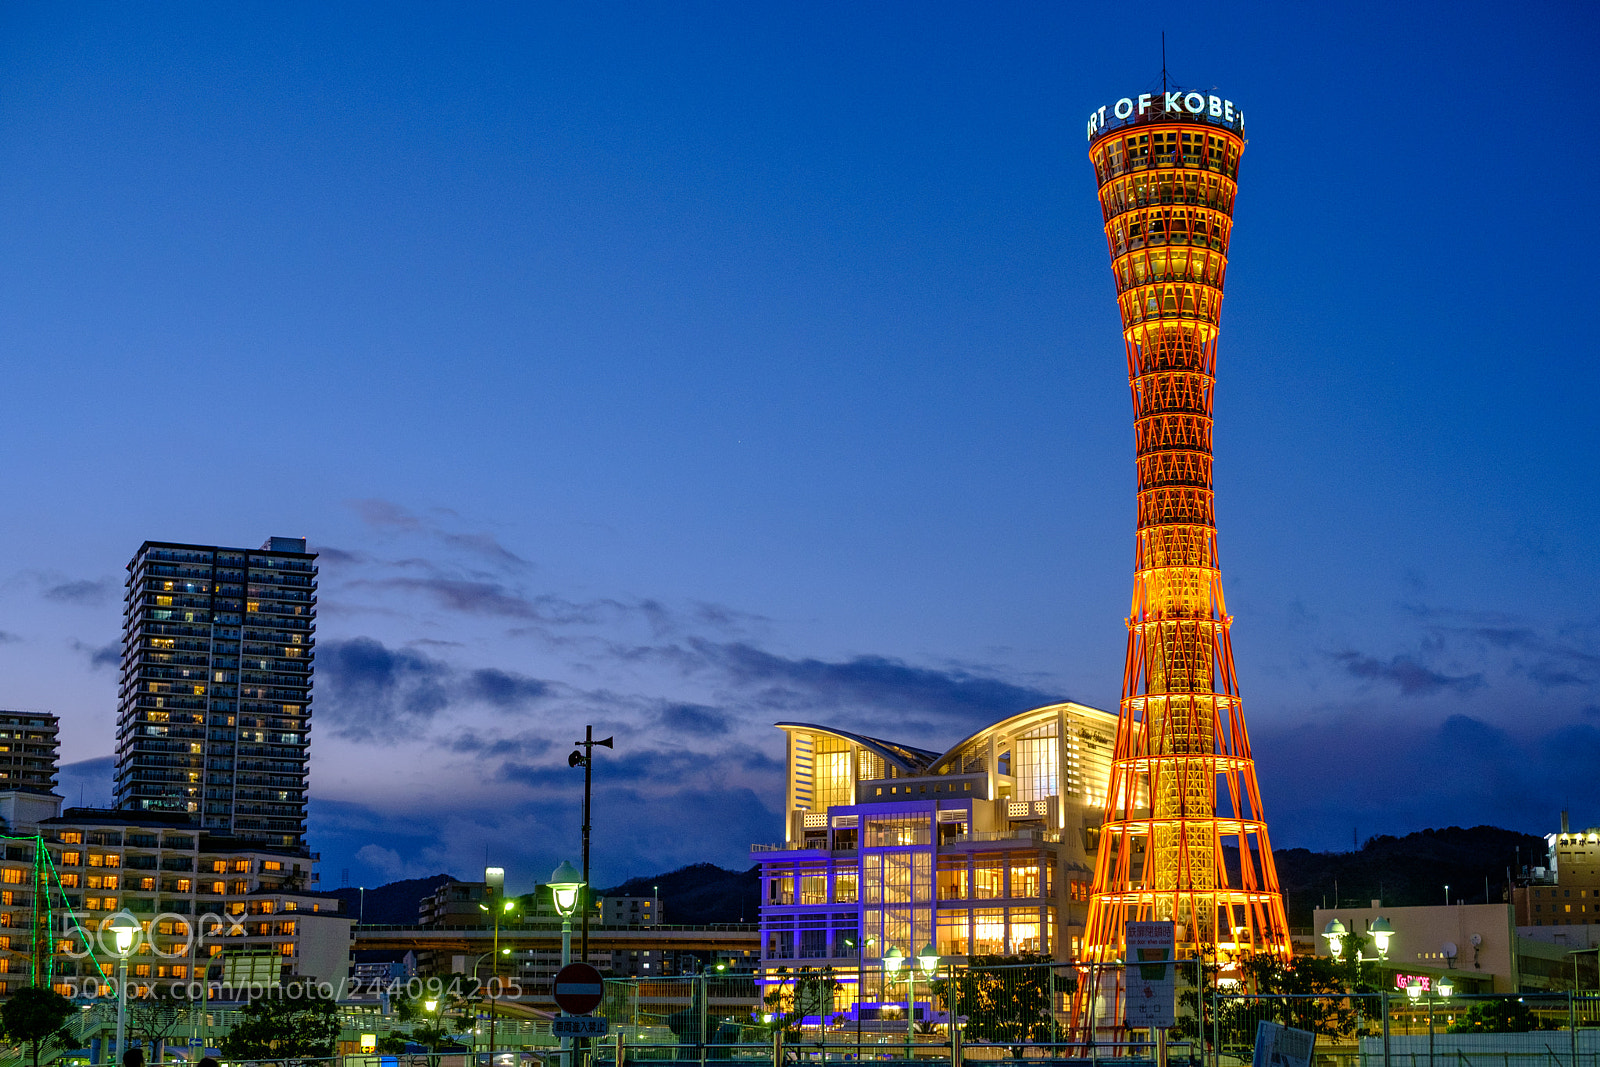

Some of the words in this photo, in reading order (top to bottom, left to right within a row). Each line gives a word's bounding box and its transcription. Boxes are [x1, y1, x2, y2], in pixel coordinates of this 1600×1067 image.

[1087, 105, 1107, 141] RT
[1114, 93, 1152, 120] OF
[1165, 91, 1235, 123] KOBE
[555, 1021, 605, 1033] 車両進入禁止
